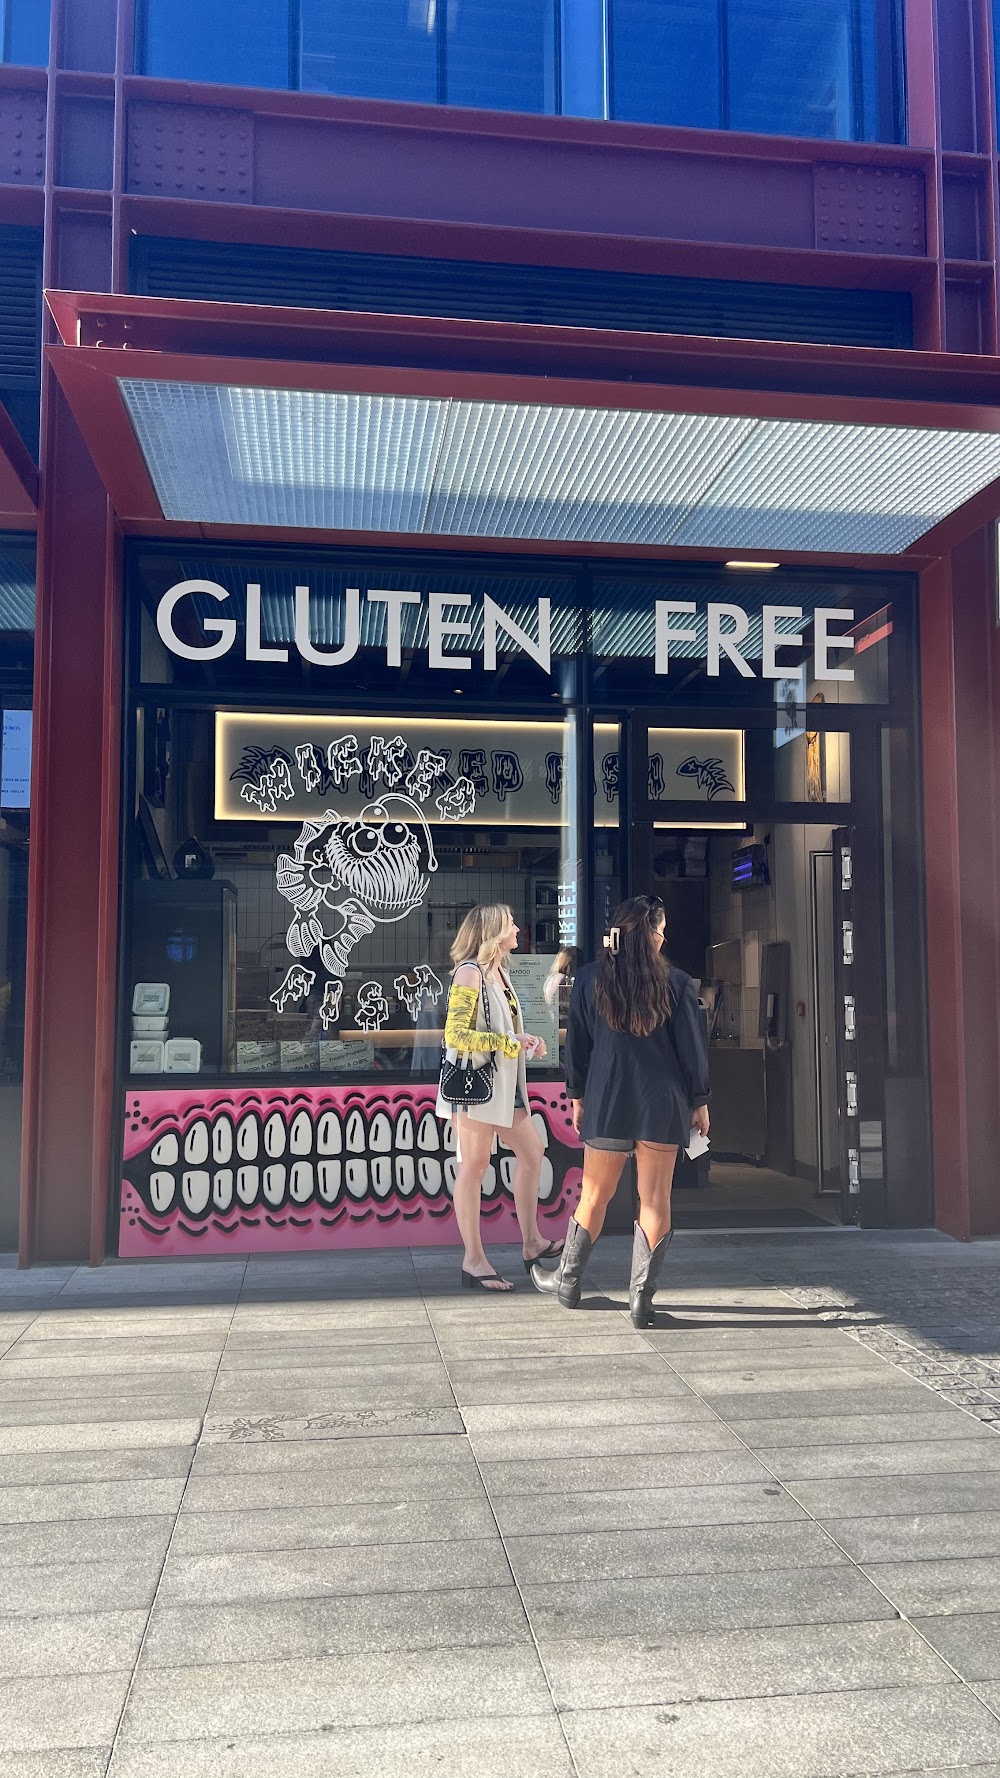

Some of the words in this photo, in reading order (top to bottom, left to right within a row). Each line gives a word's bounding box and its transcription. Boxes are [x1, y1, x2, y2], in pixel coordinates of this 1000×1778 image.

[156, 579, 551, 675] GLUTEN
[655, 600, 855, 681] FREE
[269, 964, 443, 1034] FISH
